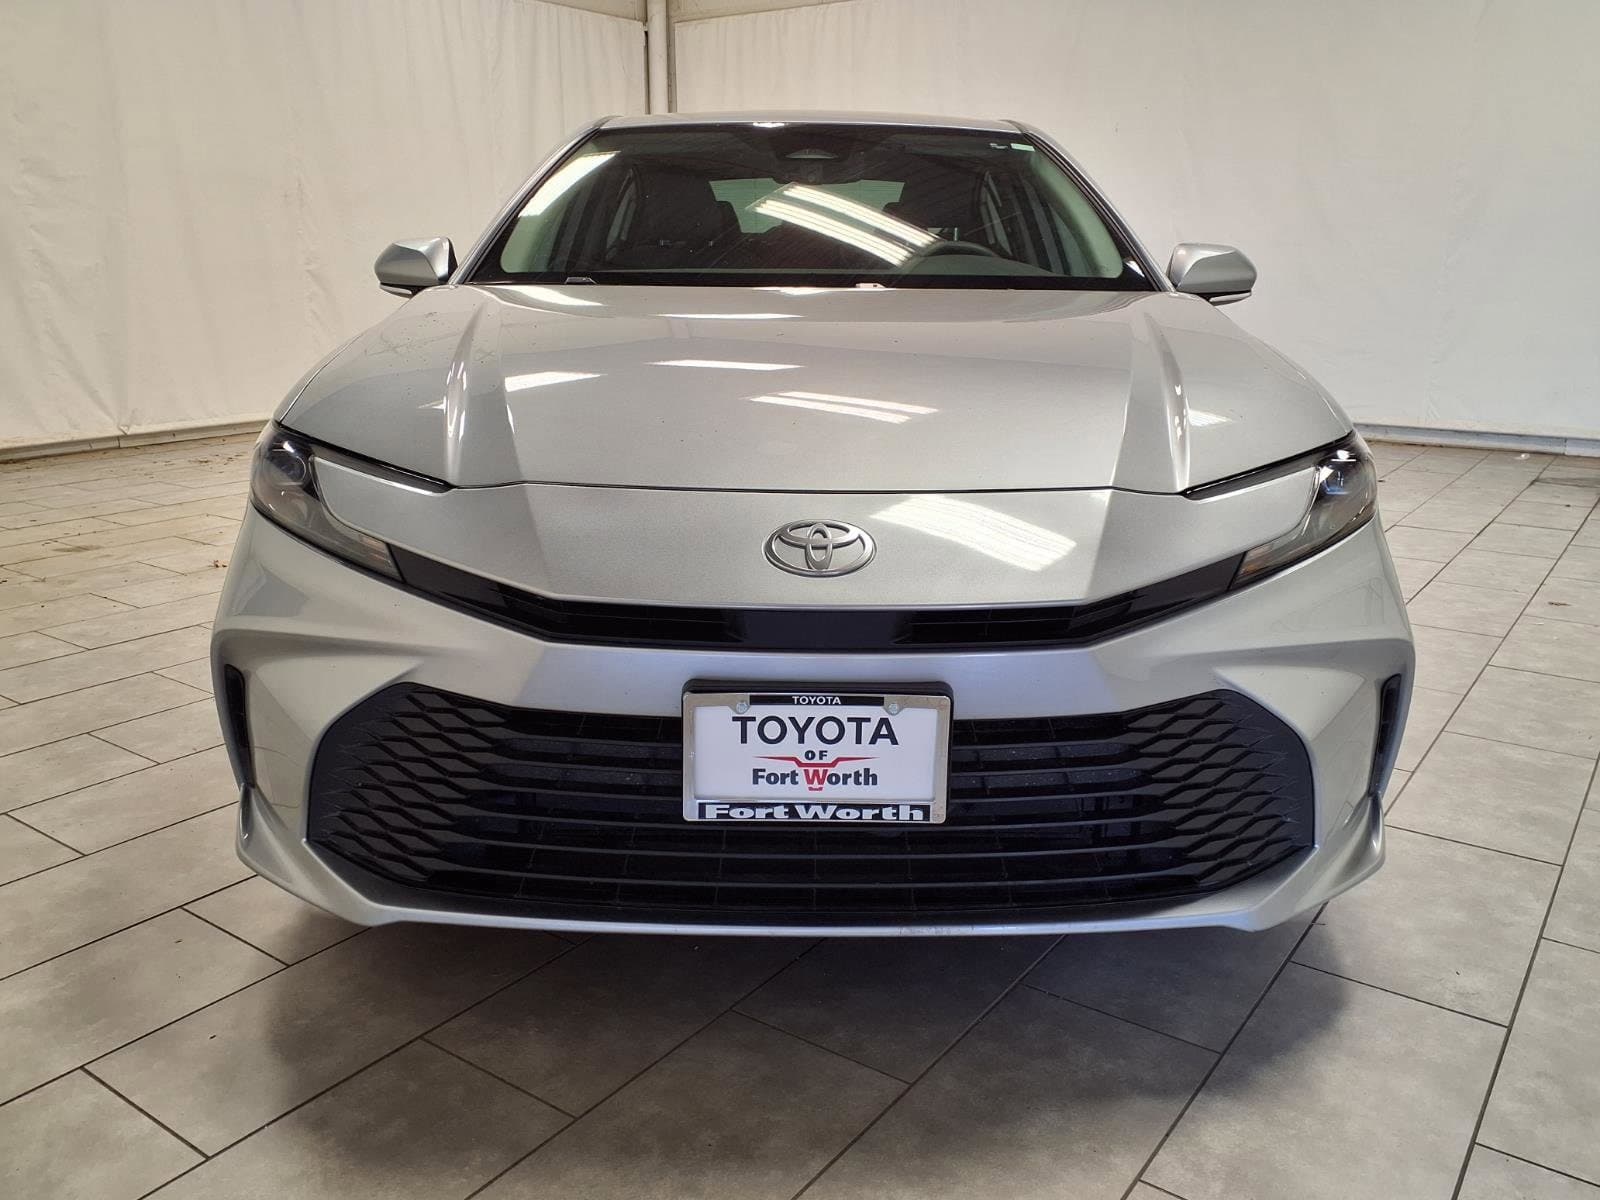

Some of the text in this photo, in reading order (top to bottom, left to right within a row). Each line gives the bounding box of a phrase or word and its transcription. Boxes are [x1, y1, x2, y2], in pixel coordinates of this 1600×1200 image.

[791, 695, 842, 705] TOYOTA
[731, 715, 899, 745] TOYOTA
[804, 750, 828, 761] OF
[752, 768, 878, 786] Fort Worth
[705, 803, 924, 820] Fort Worth
